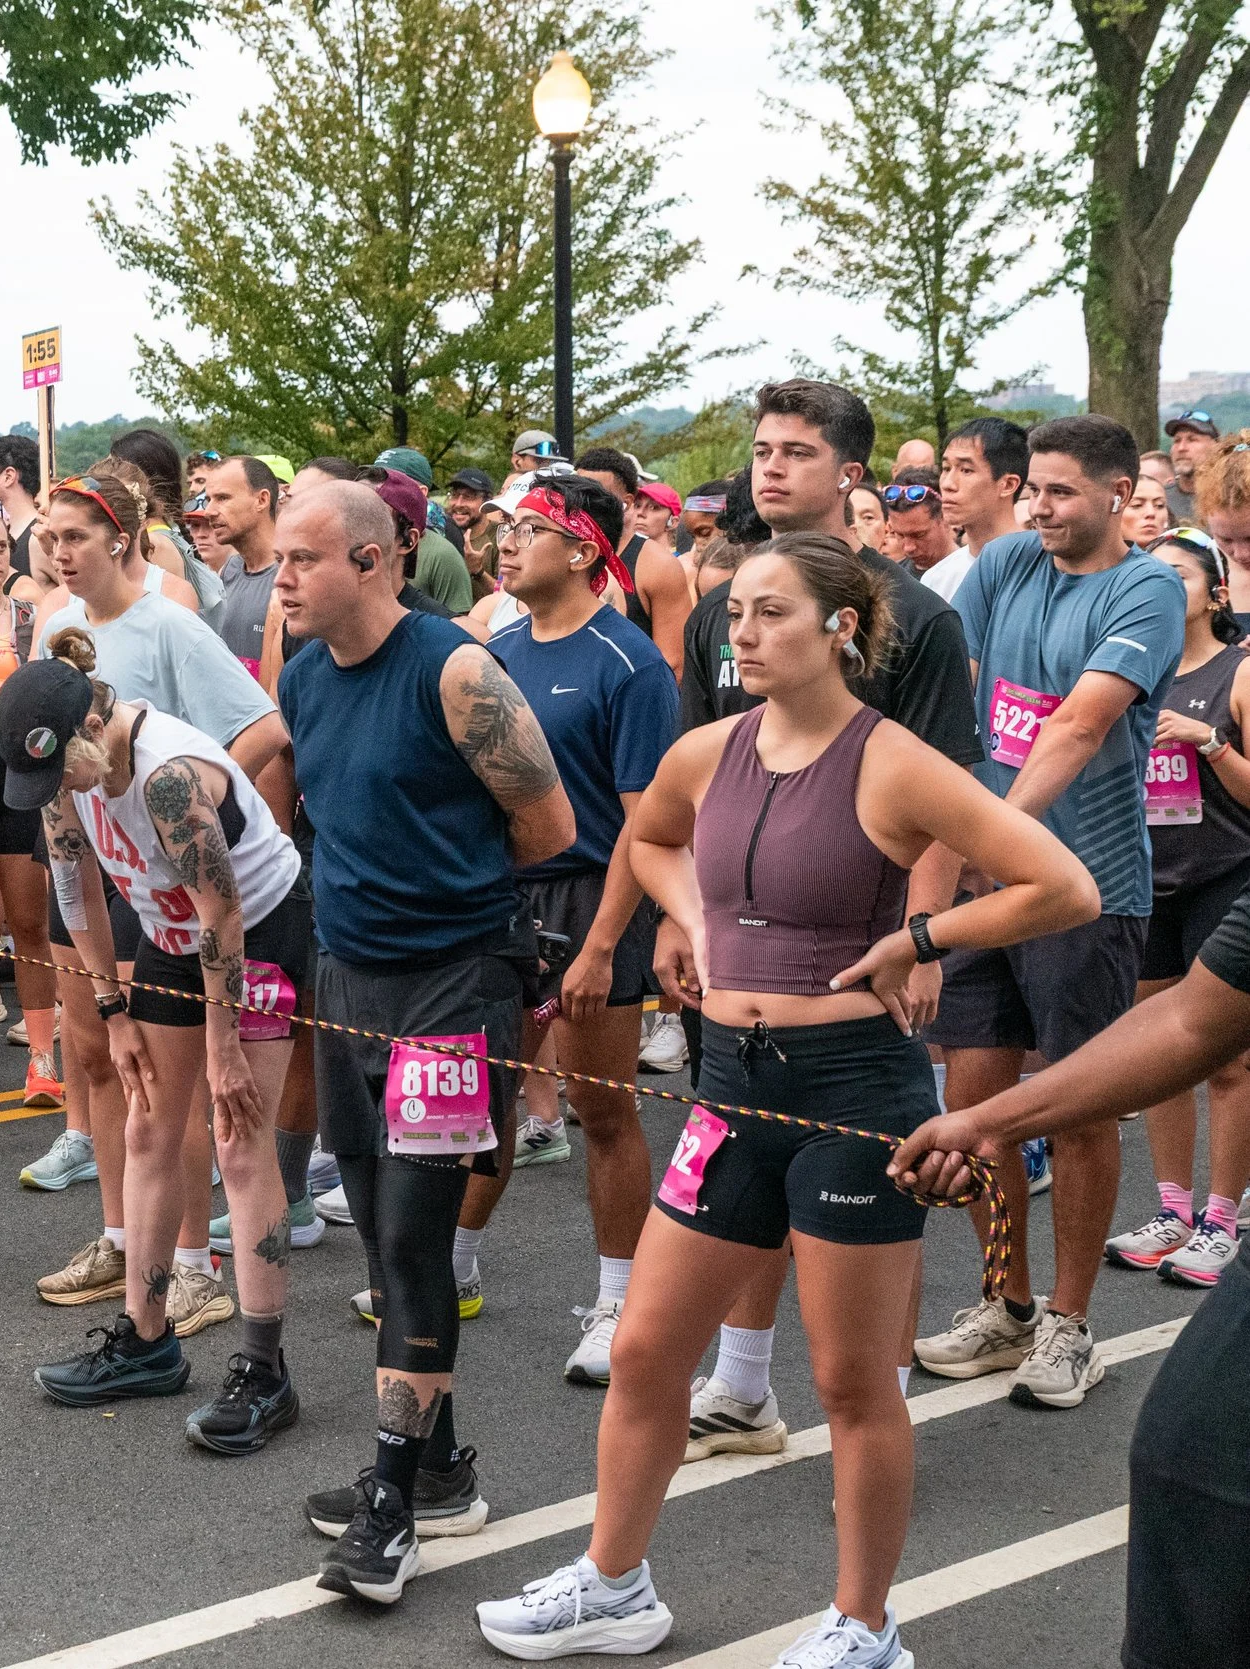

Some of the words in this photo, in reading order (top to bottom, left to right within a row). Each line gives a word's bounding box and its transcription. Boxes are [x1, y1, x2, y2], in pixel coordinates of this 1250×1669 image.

[26, 337, 56, 364] 1:55
[738, 917, 768, 927] BANDIT
[401, 1058, 479, 1097] 8139
[829, 1193, 877, 1205] BANDIT
